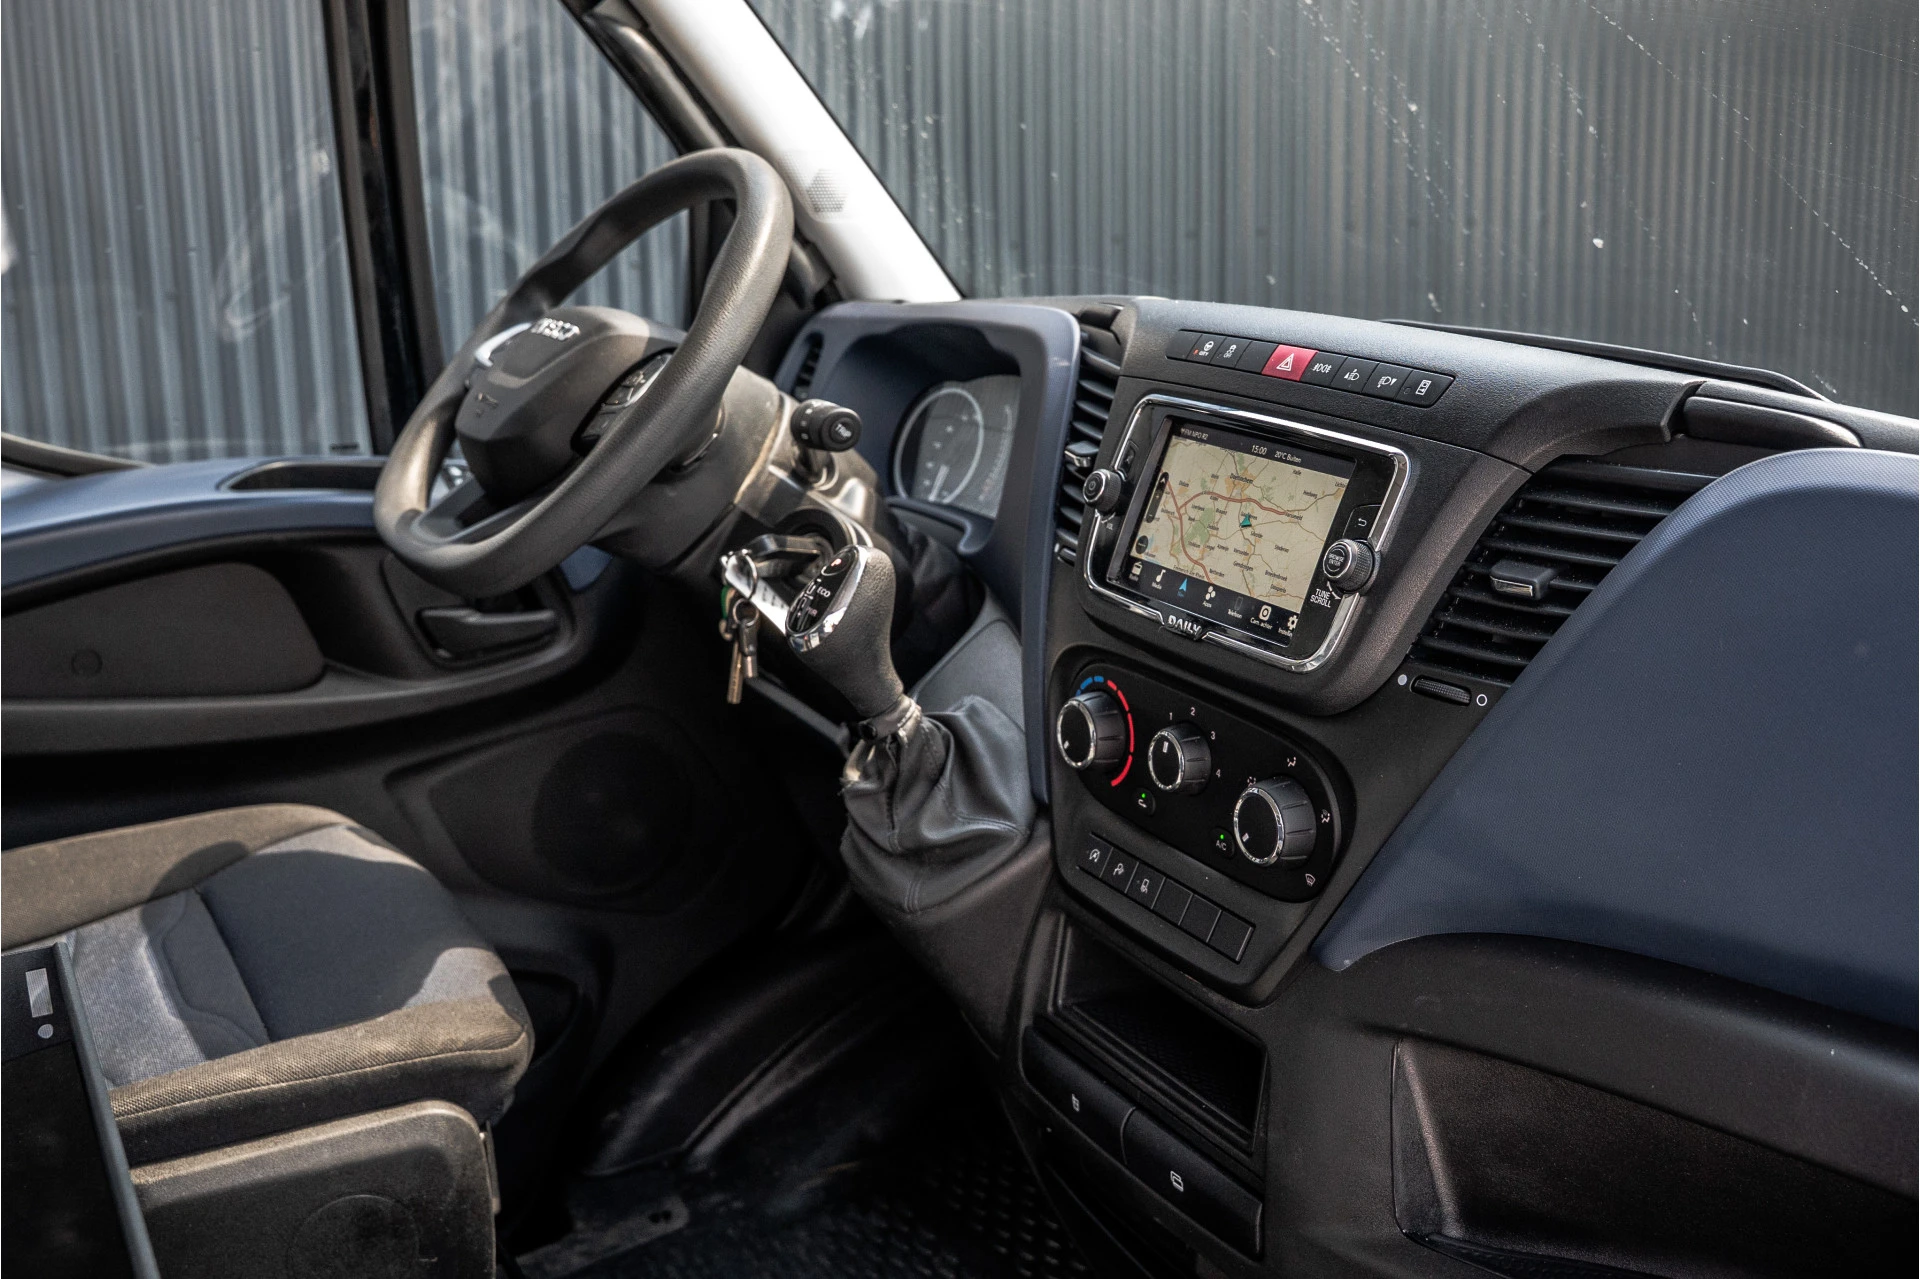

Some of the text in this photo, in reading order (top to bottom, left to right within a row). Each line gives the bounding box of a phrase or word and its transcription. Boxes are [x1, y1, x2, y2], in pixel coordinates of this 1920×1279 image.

[1251, 445, 1268, 455] 15:00
[816, 586, 831, 598] ECO
[1315, 588, 1331, 600] TUNE
[1310, 594, 1331, 608] SCROLL
[1167, 614, 1202, 636] DAILY
[1168, 712, 1173, 721] 1
[1190, 706, 1196, 716] 2
[1210, 731, 1216, 740] 3
[1215, 768, 1221, 778] 4
[1216, 839, 1227, 851] A/C
